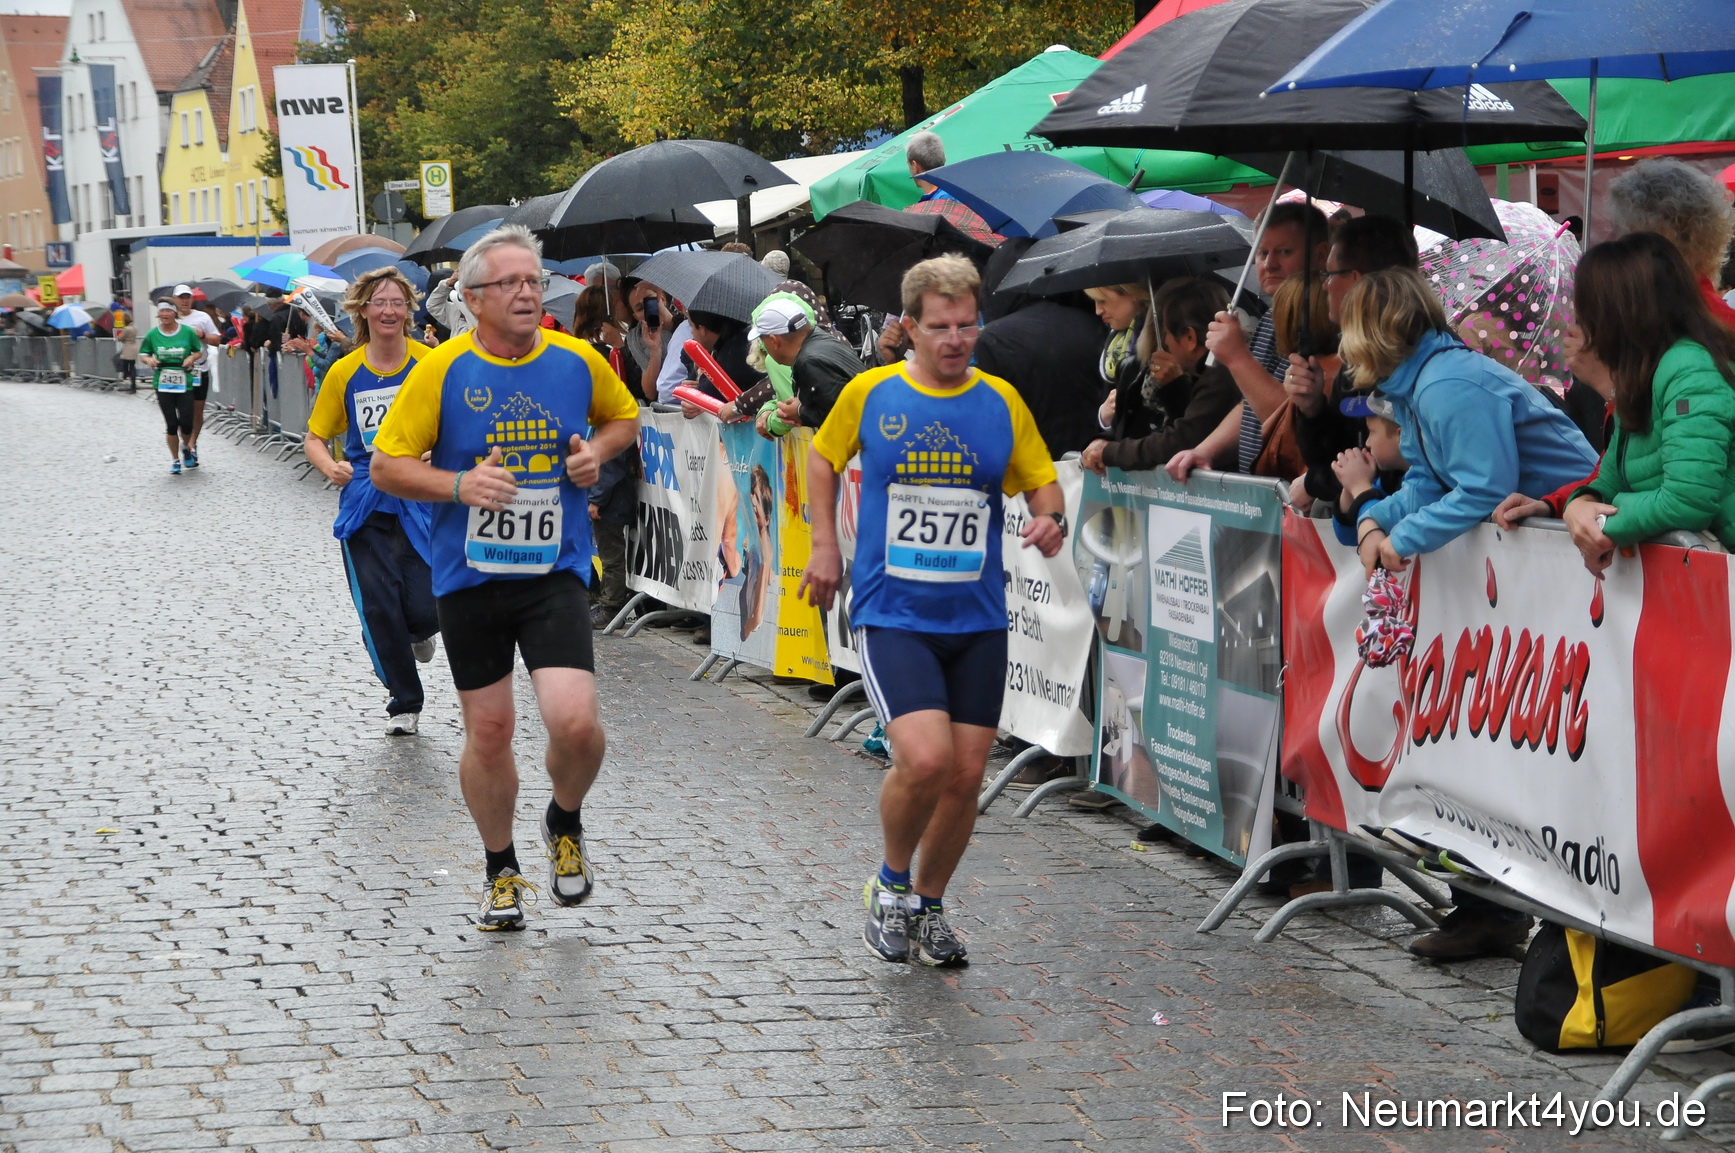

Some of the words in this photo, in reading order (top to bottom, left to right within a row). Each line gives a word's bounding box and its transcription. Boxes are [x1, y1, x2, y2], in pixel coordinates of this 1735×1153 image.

[1097, 102, 1144, 116] adidas
[162, 375, 183, 384] 2421
[363, 403, 393, 428] 22
[512, 497, 549, 506] eumarkt
[891, 493, 925, 505] PARTL
[927, 497, 974, 507] Neumarkt
[477, 507, 554, 541] 2616
[897, 508, 979, 546] 2576
[1002, 505, 1026, 537] Kast
[484, 547, 543, 564] Wolfgang
[914, 553, 957, 568] Rudolf
[1154, 568, 1177, 589] MATHI
[1179, 574, 1209, 597] HOFFER
[1007, 609, 1020, 632] er
[1008, 661, 1036, 696] 2318
[1167, 722, 1196, 747] Trockenbau
